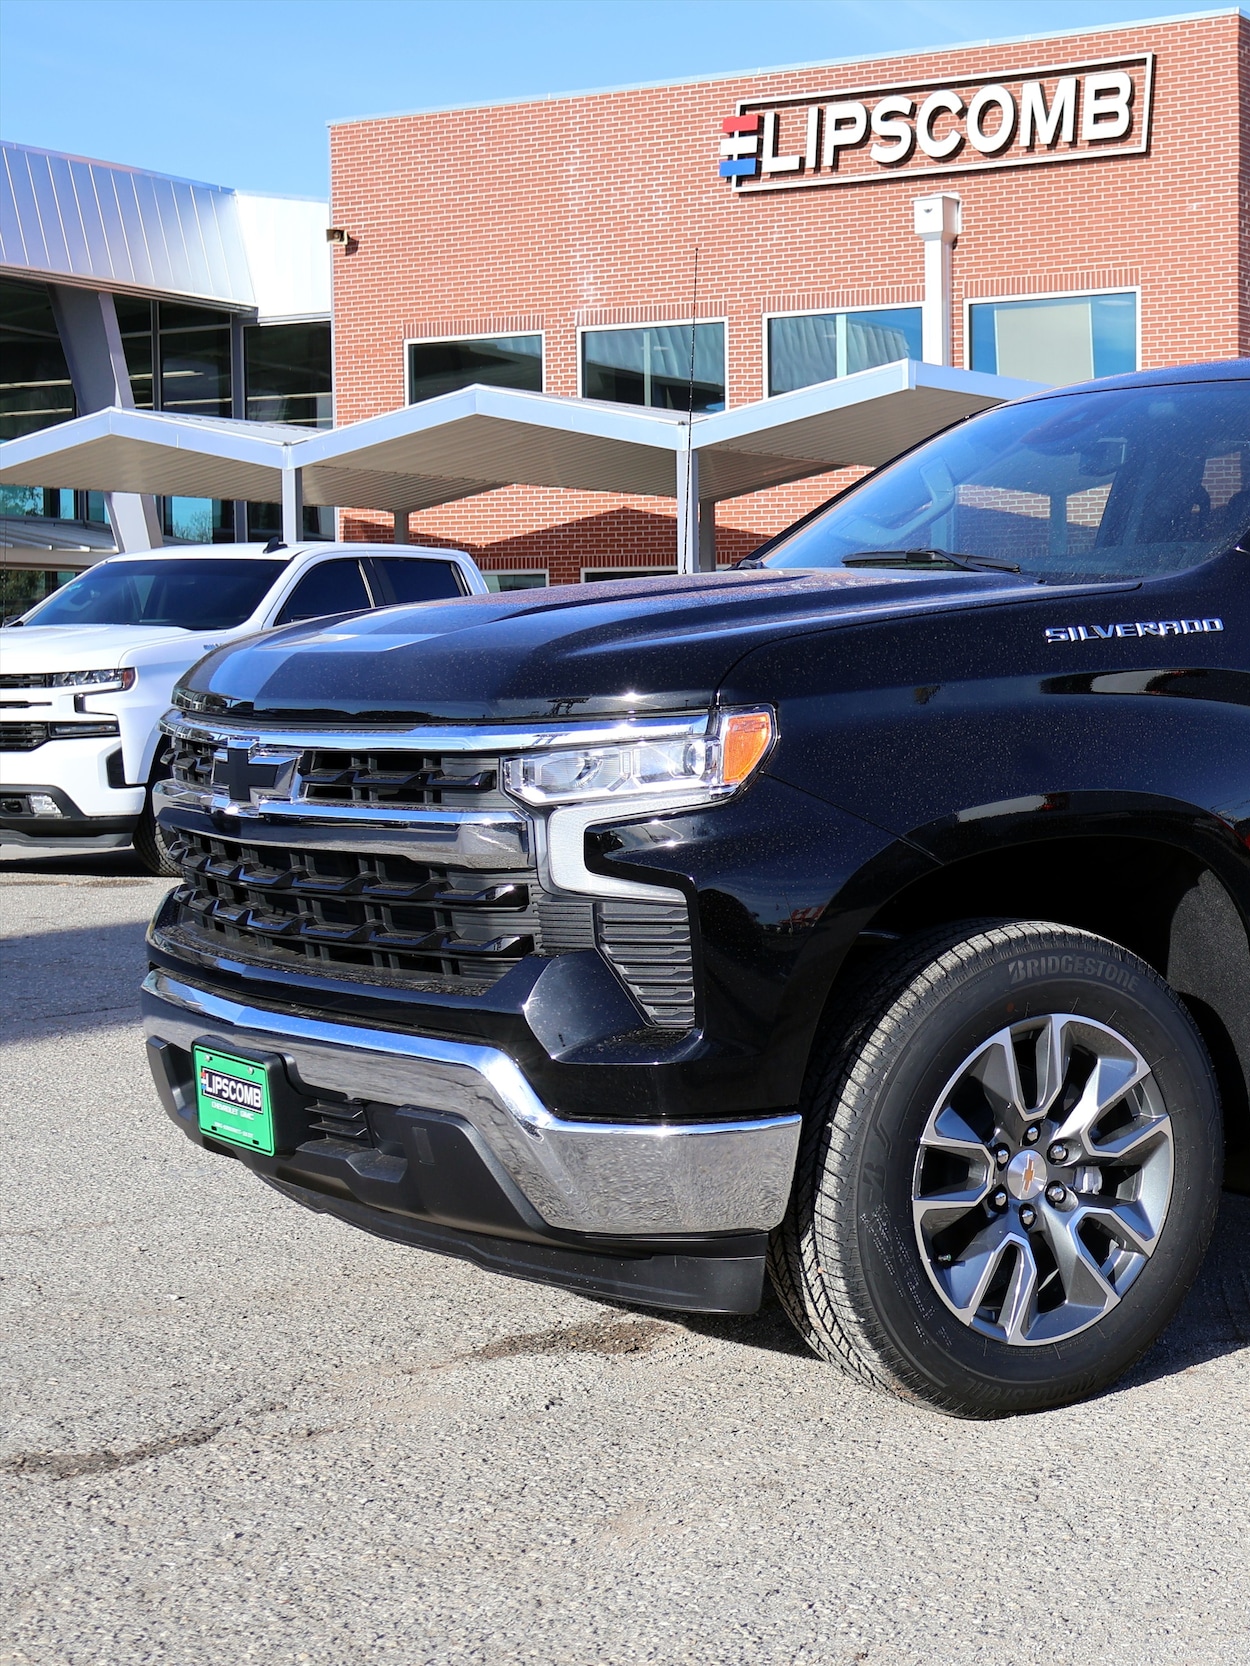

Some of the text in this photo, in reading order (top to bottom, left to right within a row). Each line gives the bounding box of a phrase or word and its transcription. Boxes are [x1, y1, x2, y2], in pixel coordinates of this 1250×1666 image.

[762, 71, 1133, 173] LIPSCOMB
[1045, 617, 1225, 643] SILVERADO
[1008, 954, 1141, 993] BRIDGESTONE
[205, 1072, 262, 1108] LIPSCOMB
